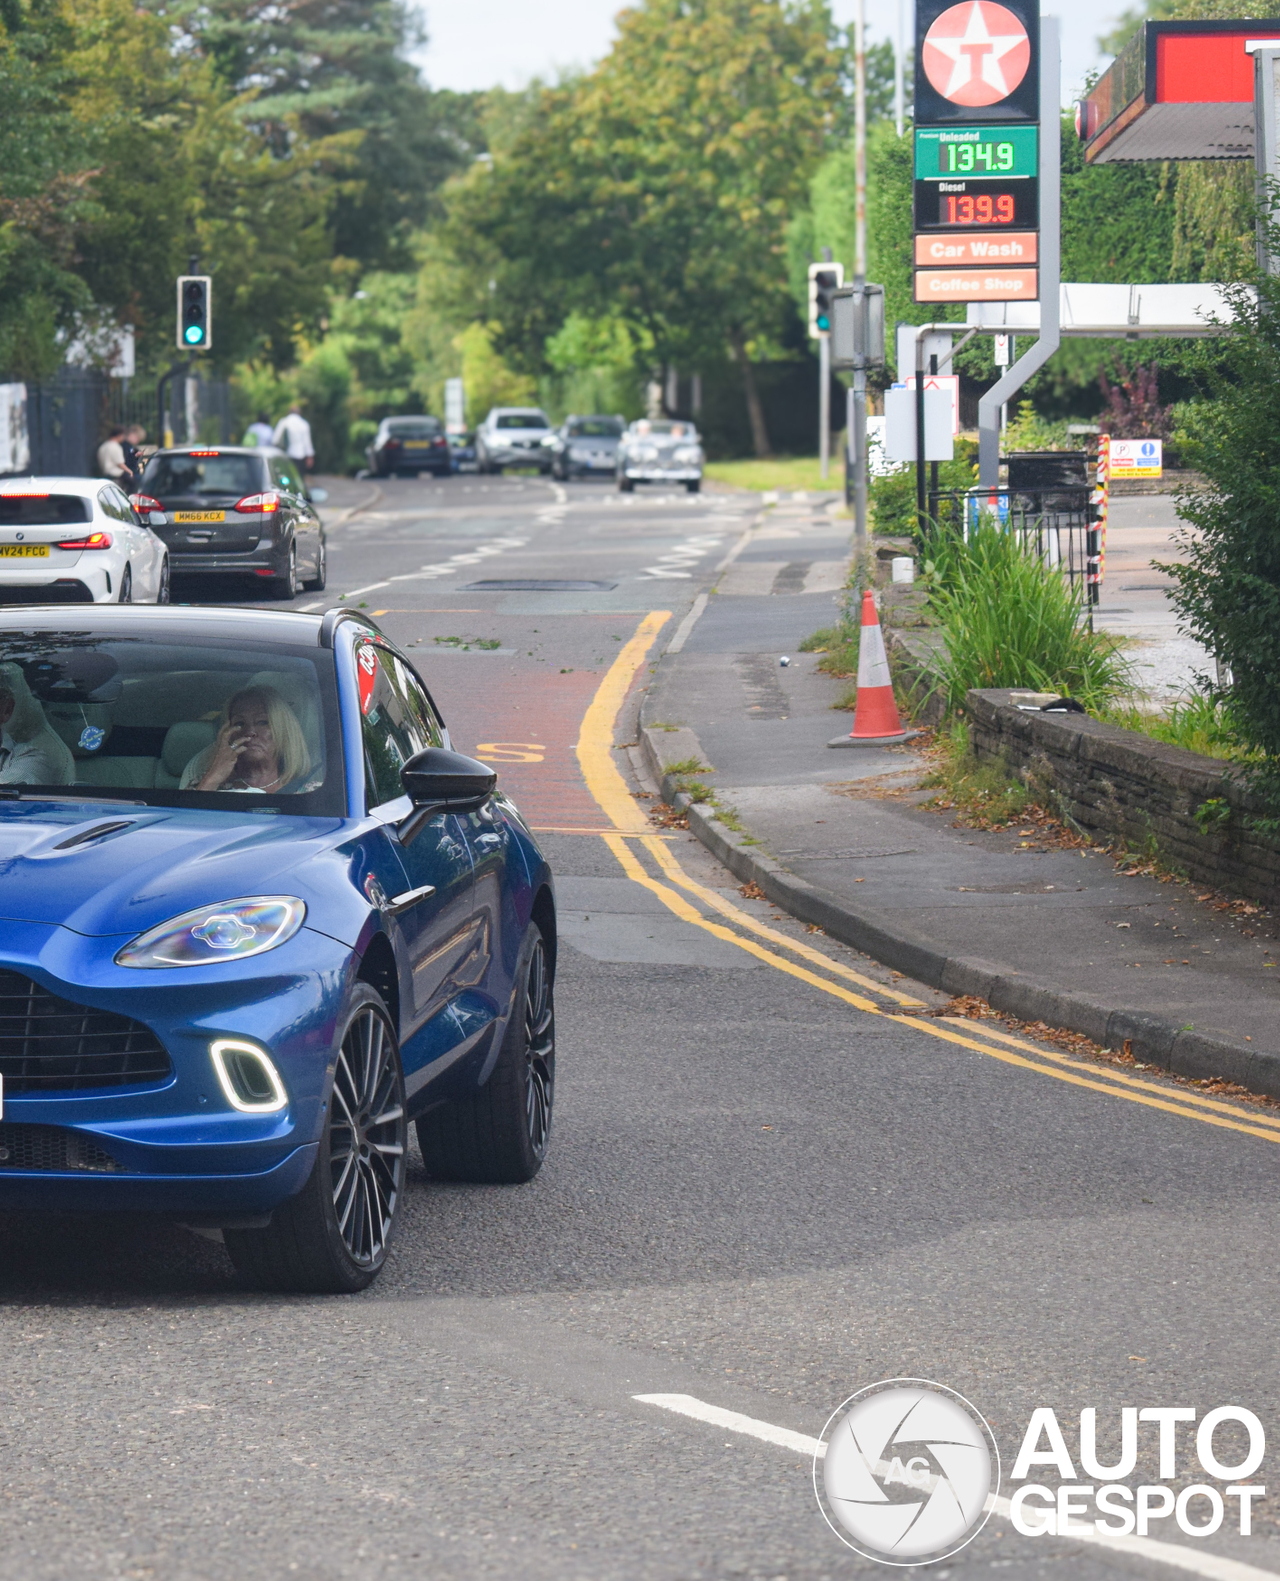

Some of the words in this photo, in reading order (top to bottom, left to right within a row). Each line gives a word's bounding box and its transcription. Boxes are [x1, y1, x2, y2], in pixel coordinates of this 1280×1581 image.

[940, 131, 980, 142] Unleaded
[947, 142, 1014, 172] 134.9
[939, 182, 966, 192] Diesel
[947, 195, 1014, 224] 139.9
[930, 242, 965, 258] Car
[970, 241, 1023, 257] Wash
[929, 278, 980, 292] Coffee
[984, 277, 1023, 292] Shop
[179, 512, 202, 520] MM66
[204, 512, 222, 520] KCX
[26, 546, 46, 556] FCG
